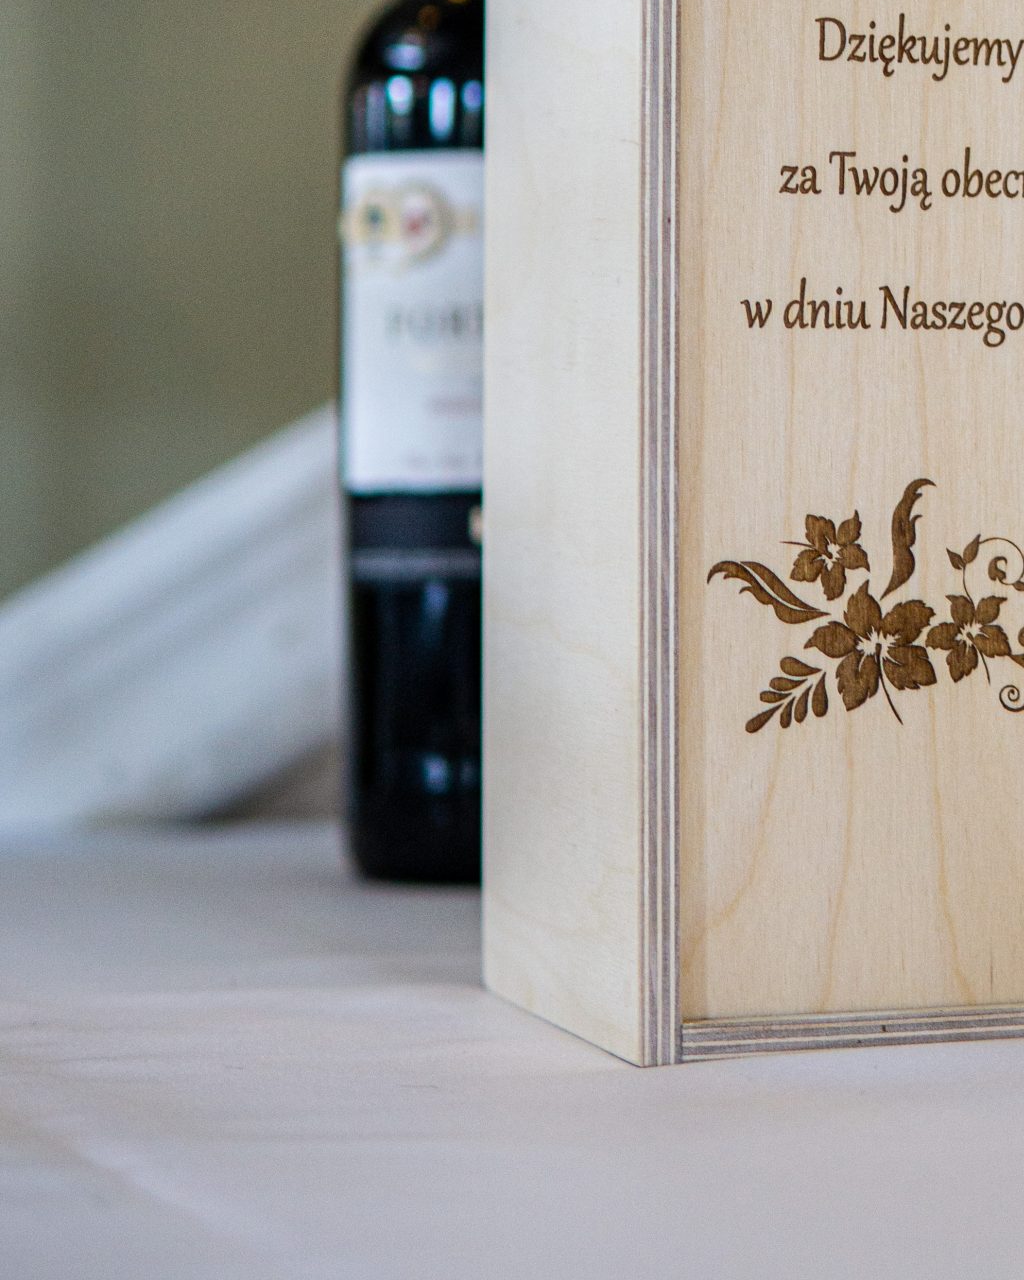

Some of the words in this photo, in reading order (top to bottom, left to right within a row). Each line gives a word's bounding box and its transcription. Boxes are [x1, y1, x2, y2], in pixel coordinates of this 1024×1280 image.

[814, 12, 1024, 84] Dziękujemy
[778, 165, 822, 196] za
[828, 150, 934, 214] Twoją
[740, 297, 773, 330] w
[783, 276, 873, 331] dniu
